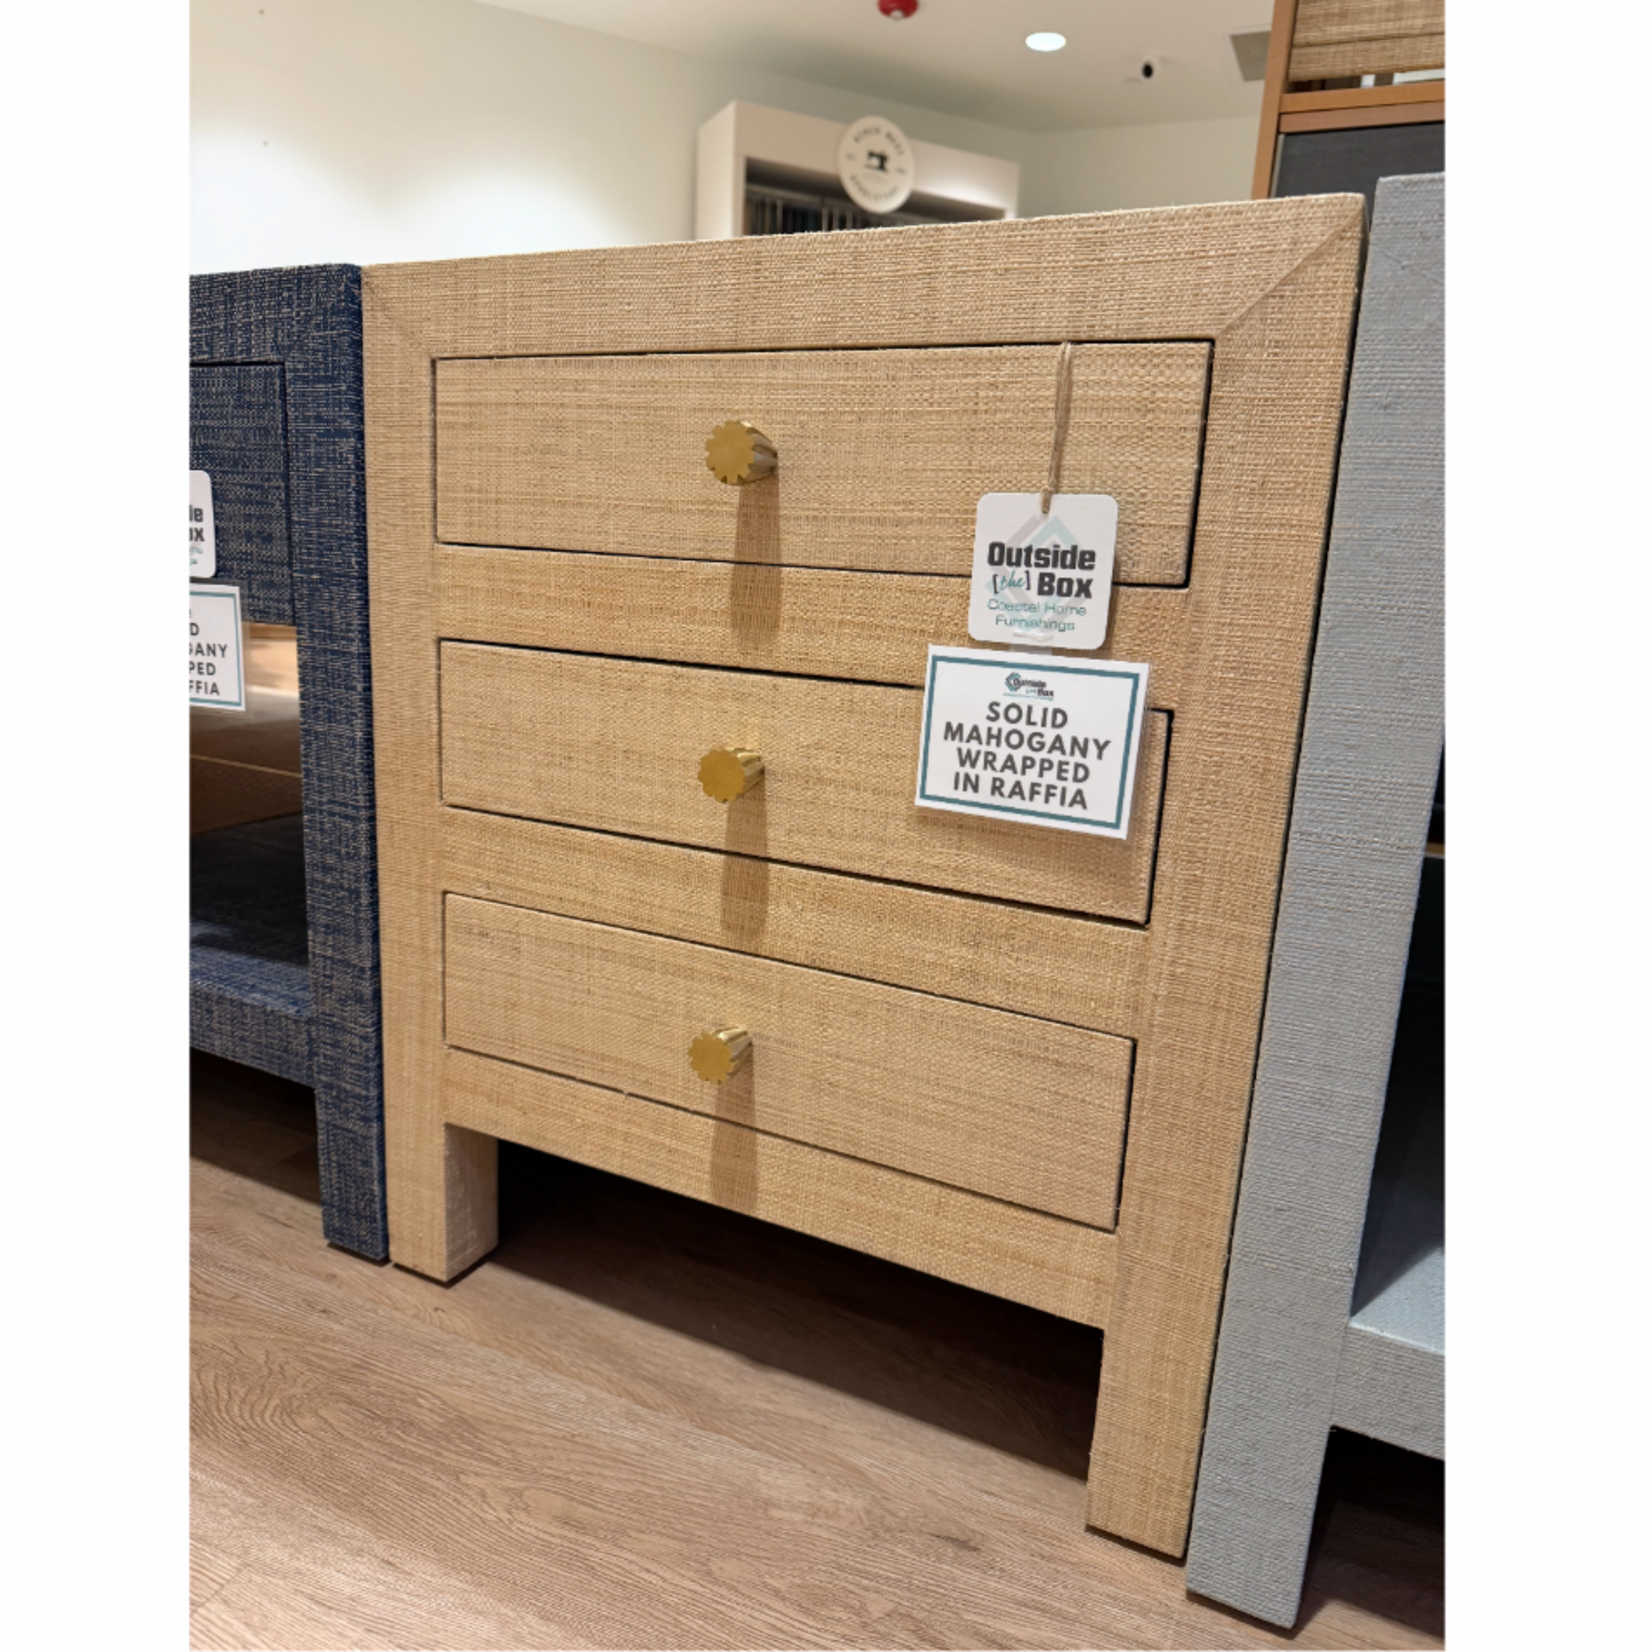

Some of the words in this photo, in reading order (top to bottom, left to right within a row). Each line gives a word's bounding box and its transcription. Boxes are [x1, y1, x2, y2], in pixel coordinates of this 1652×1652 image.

[987, 541, 1096, 571] Outside
[1037, 572, 1093, 599] Box
[987, 598, 1040, 613] Coastal
[1044, 602, 1087, 616] Home
[995, 614, 1075, 632] Furnishings
[985, 701, 1068, 729] SOLID
[943, 721, 1111, 760] MAHOGANY
[956, 747, 1090, 783] WRAPPED
[953, 771, 980, 794] IN
[990, 777, 1088, 810] RAFFIA
